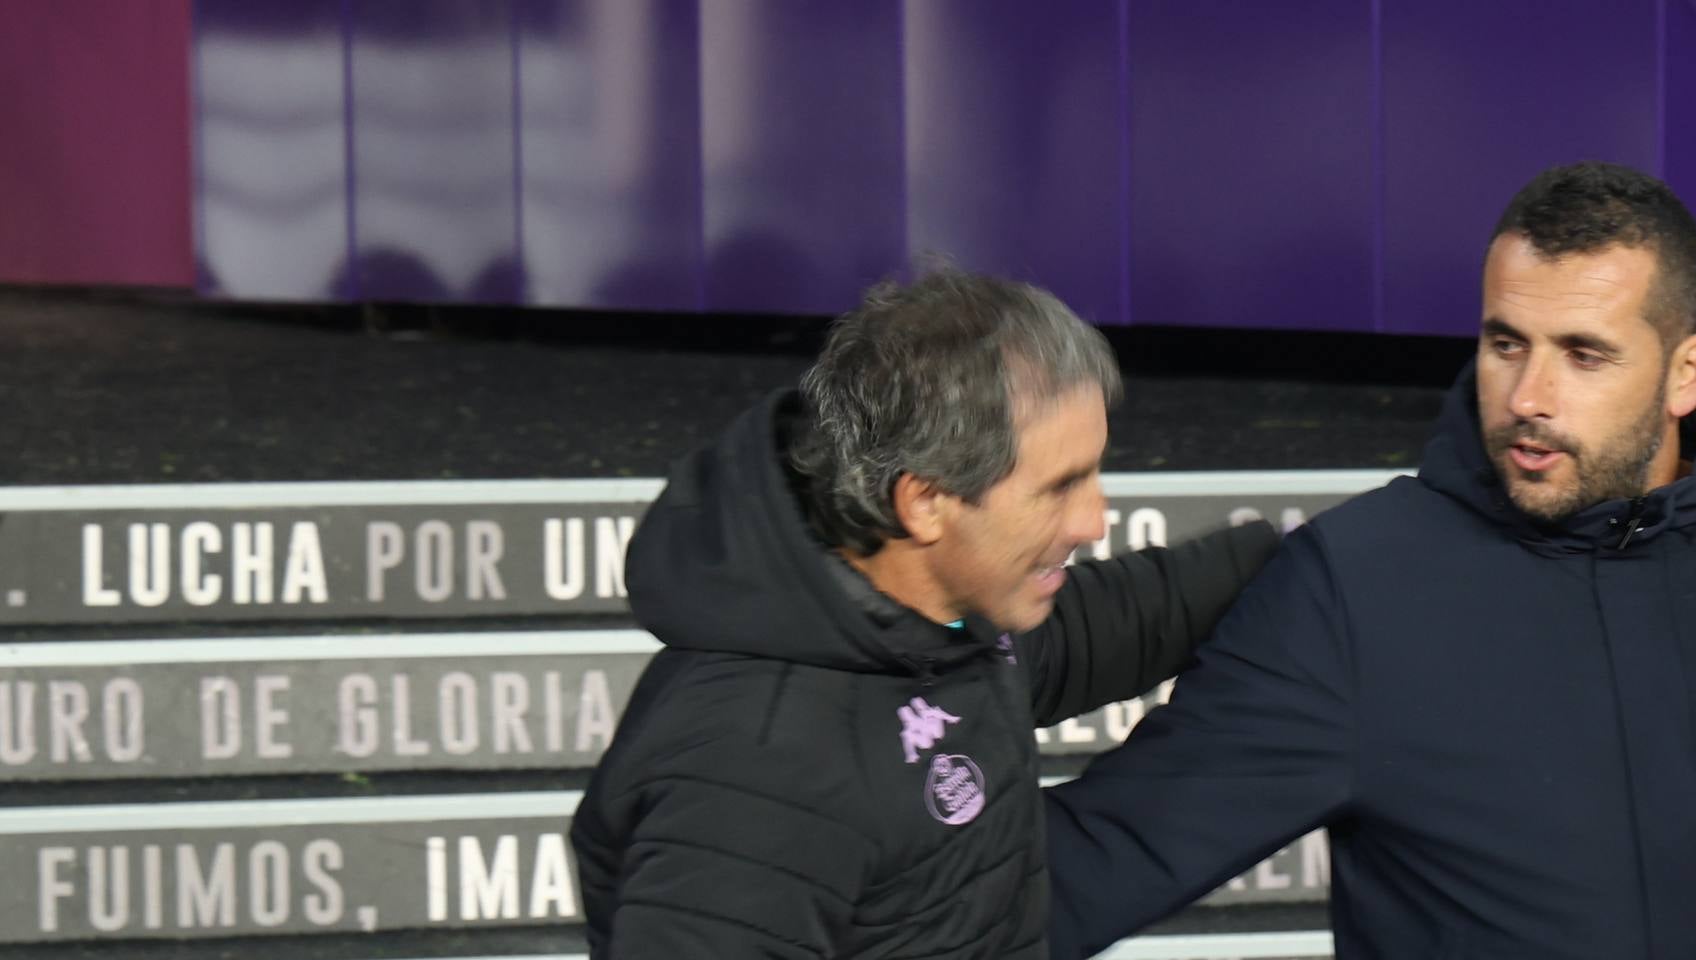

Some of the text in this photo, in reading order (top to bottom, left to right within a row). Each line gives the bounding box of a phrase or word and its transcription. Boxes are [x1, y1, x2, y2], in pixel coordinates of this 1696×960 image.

[83, 522, 328, 606] LUCHA
[366, 519, 506, 601] POR
[202, 676, 291, 760] DE
[337, 669, 618, 758] GLORIA
[38, 838, 379, 932] FUIMOS,
